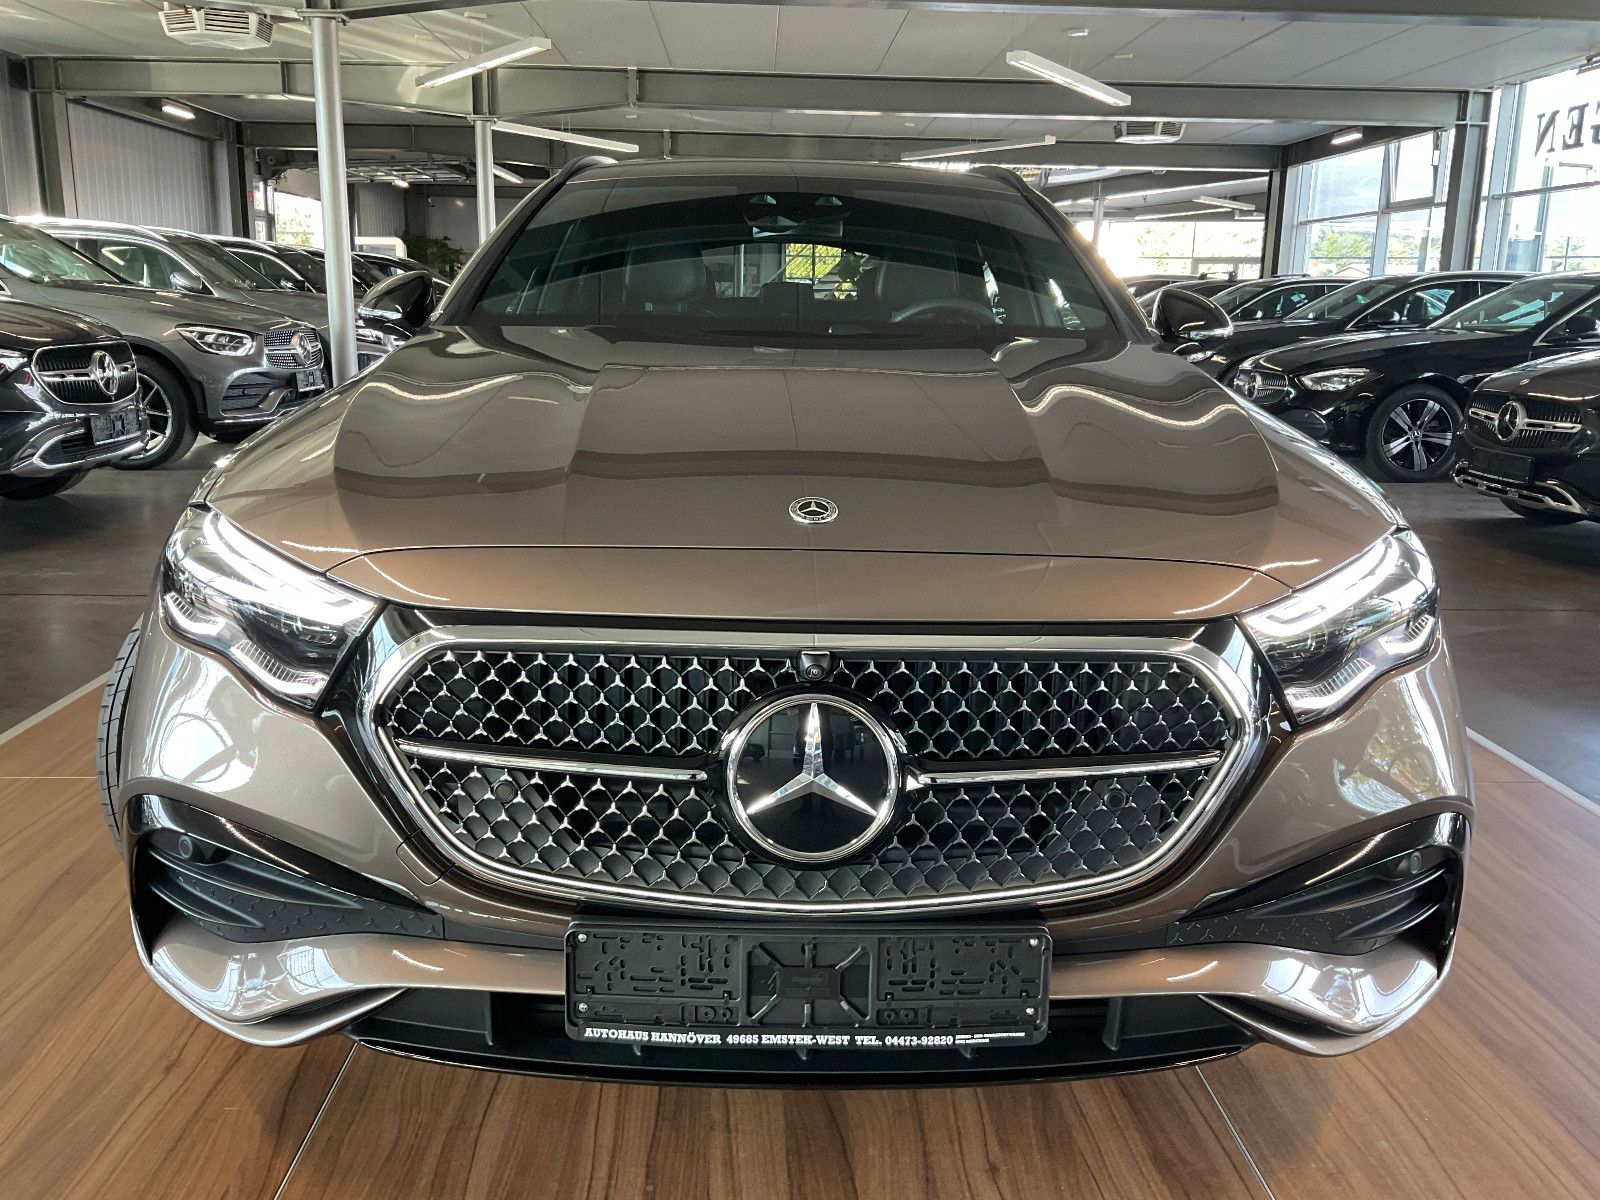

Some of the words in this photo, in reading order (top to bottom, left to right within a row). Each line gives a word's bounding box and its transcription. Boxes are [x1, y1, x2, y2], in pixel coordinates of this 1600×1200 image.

[584, 1028, 649, 1041] AUTOHAUS
[651, 1032, 722, 1044] HANNÖVER
[726, 1034, 760, 1044] 49685
[761, 1034, 851, 1045] EMSTEK-WEST
[855, 1035, 883, 1045] TEL.
[885, 1035, 954, 1045] 04473-92820
